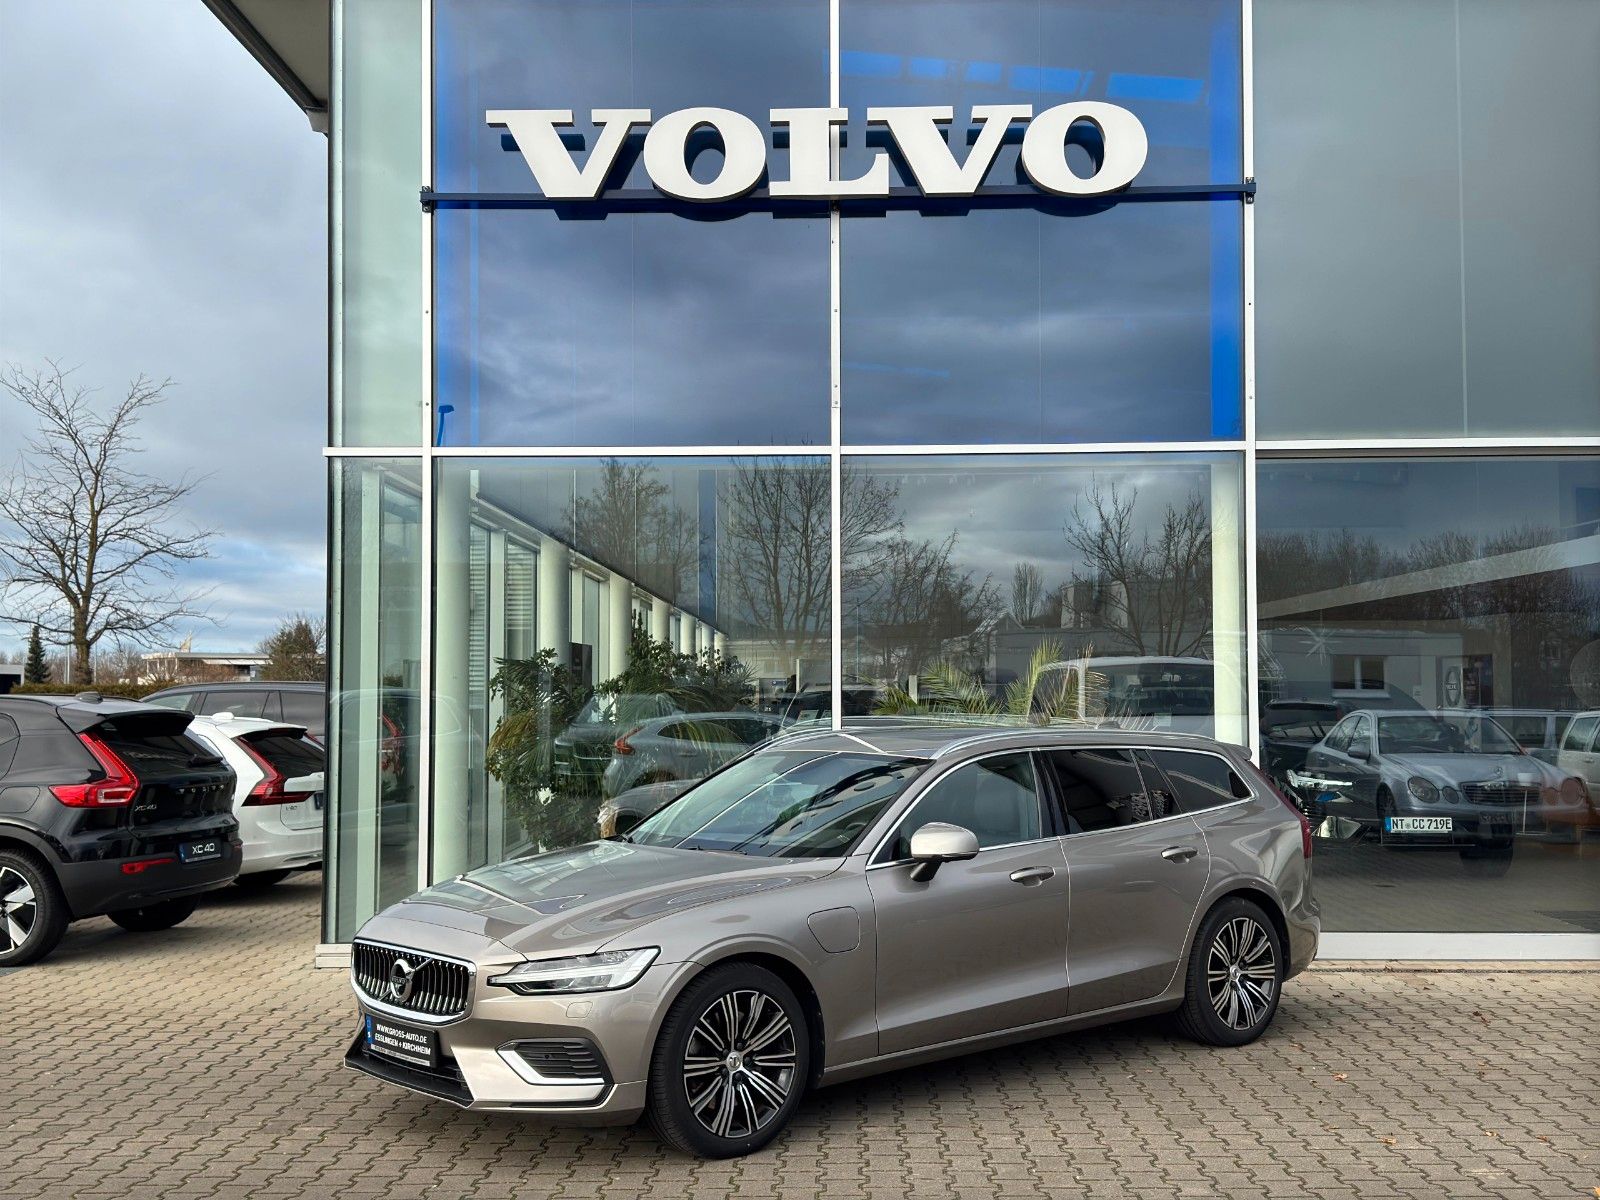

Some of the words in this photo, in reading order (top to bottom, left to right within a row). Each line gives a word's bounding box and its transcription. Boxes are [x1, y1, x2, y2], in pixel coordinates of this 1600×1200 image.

[486, 102, 1149, 201] VOLVO
[1392, 818, 1405, 830] NT
[1412, 818, 1425, 830] CC
[1427, 818, 1451, 830] 719E
[374, 1032, 399, 1047] ESSLINGEN
[402, 1041, 431, 1056] KIRCHHEIM
[376, 1023, 427, 1044] WWW.GROSS-AUTO.DE
